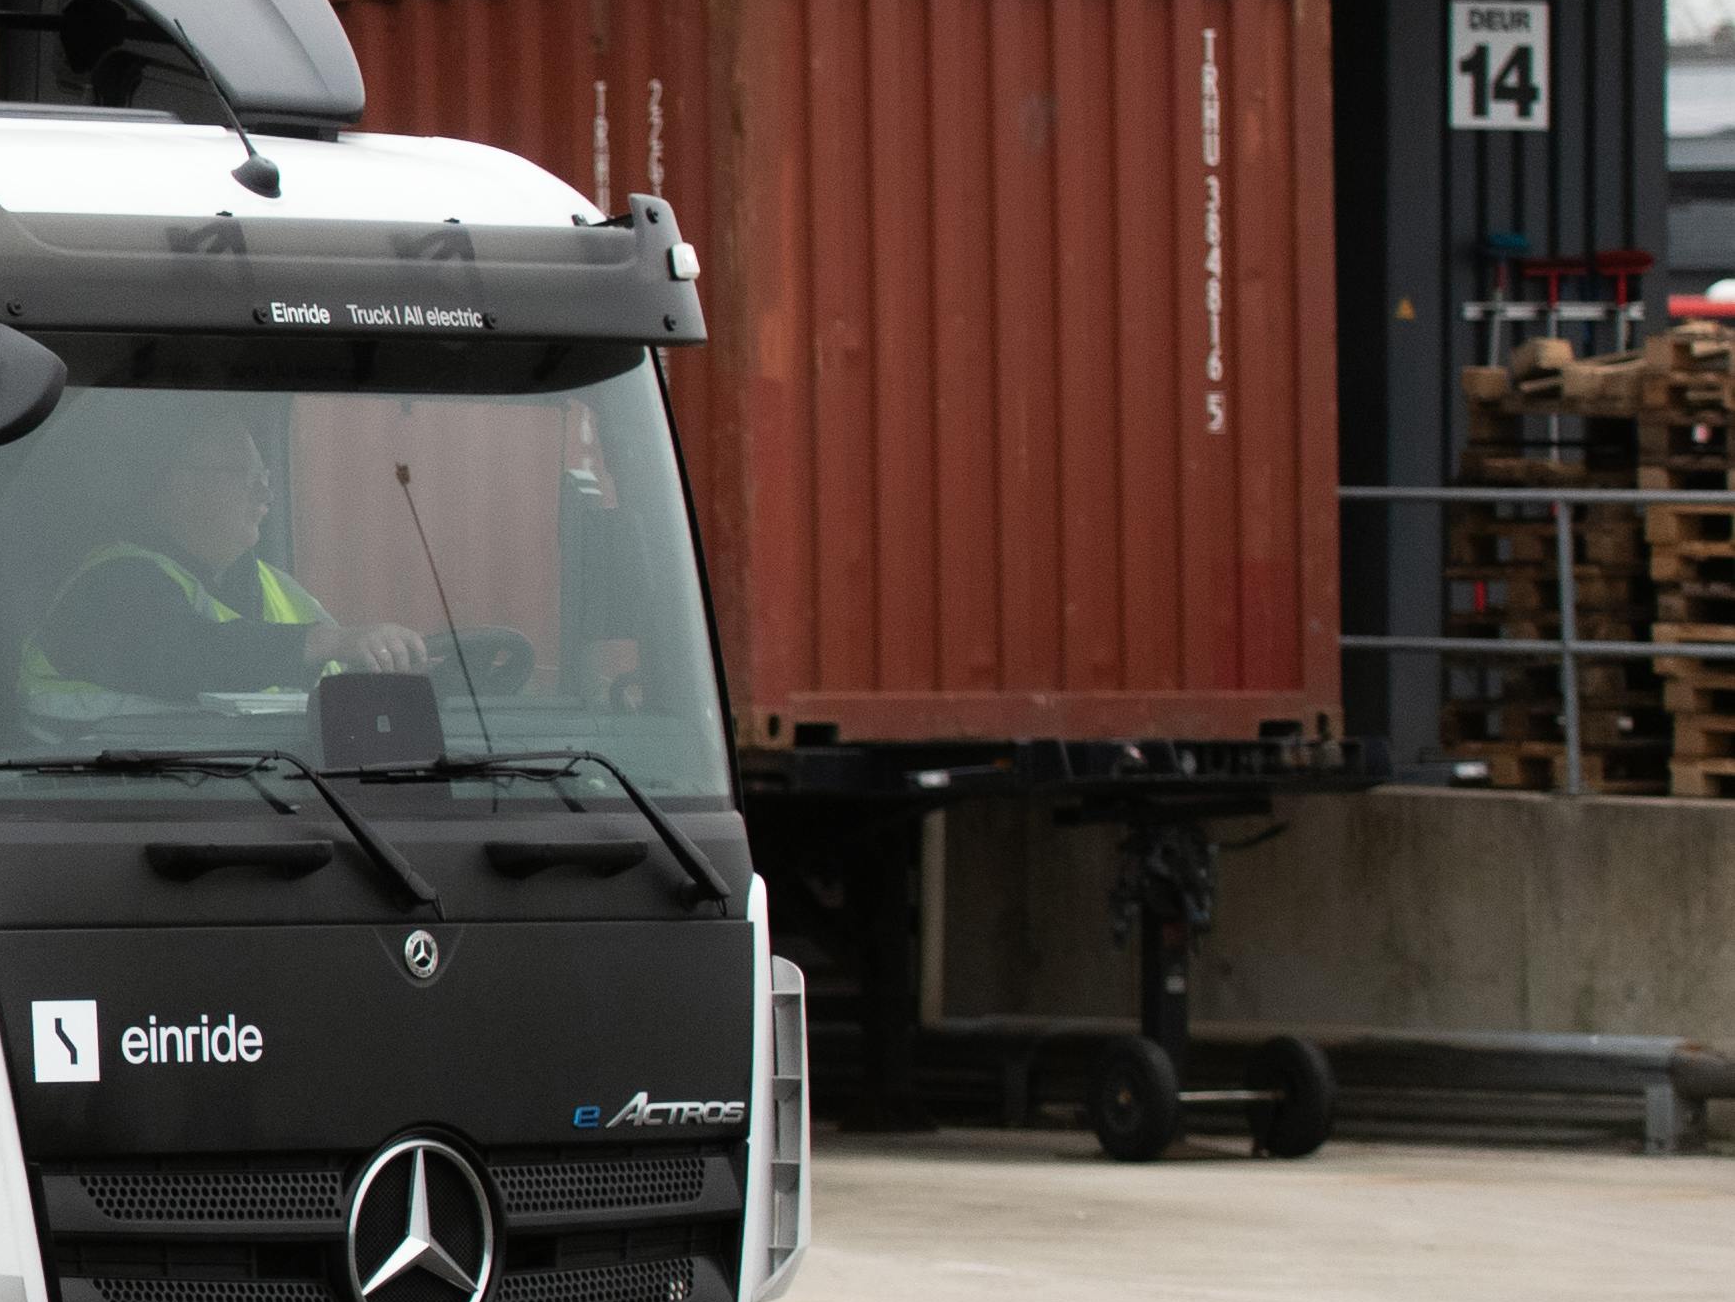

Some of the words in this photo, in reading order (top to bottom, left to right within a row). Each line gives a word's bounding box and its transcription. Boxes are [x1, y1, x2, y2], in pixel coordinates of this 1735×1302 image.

[1468, 7, 1531, 31] DEUR
[1460, 43, 1540, 117] 14
[270, 302, 331, 325] Einride
[346, 304, 392, 325] Truck
[403, 305, 425, 326] All
[426, 307, 484, 328] electric
[121, 1014, 263, 1064] einride
